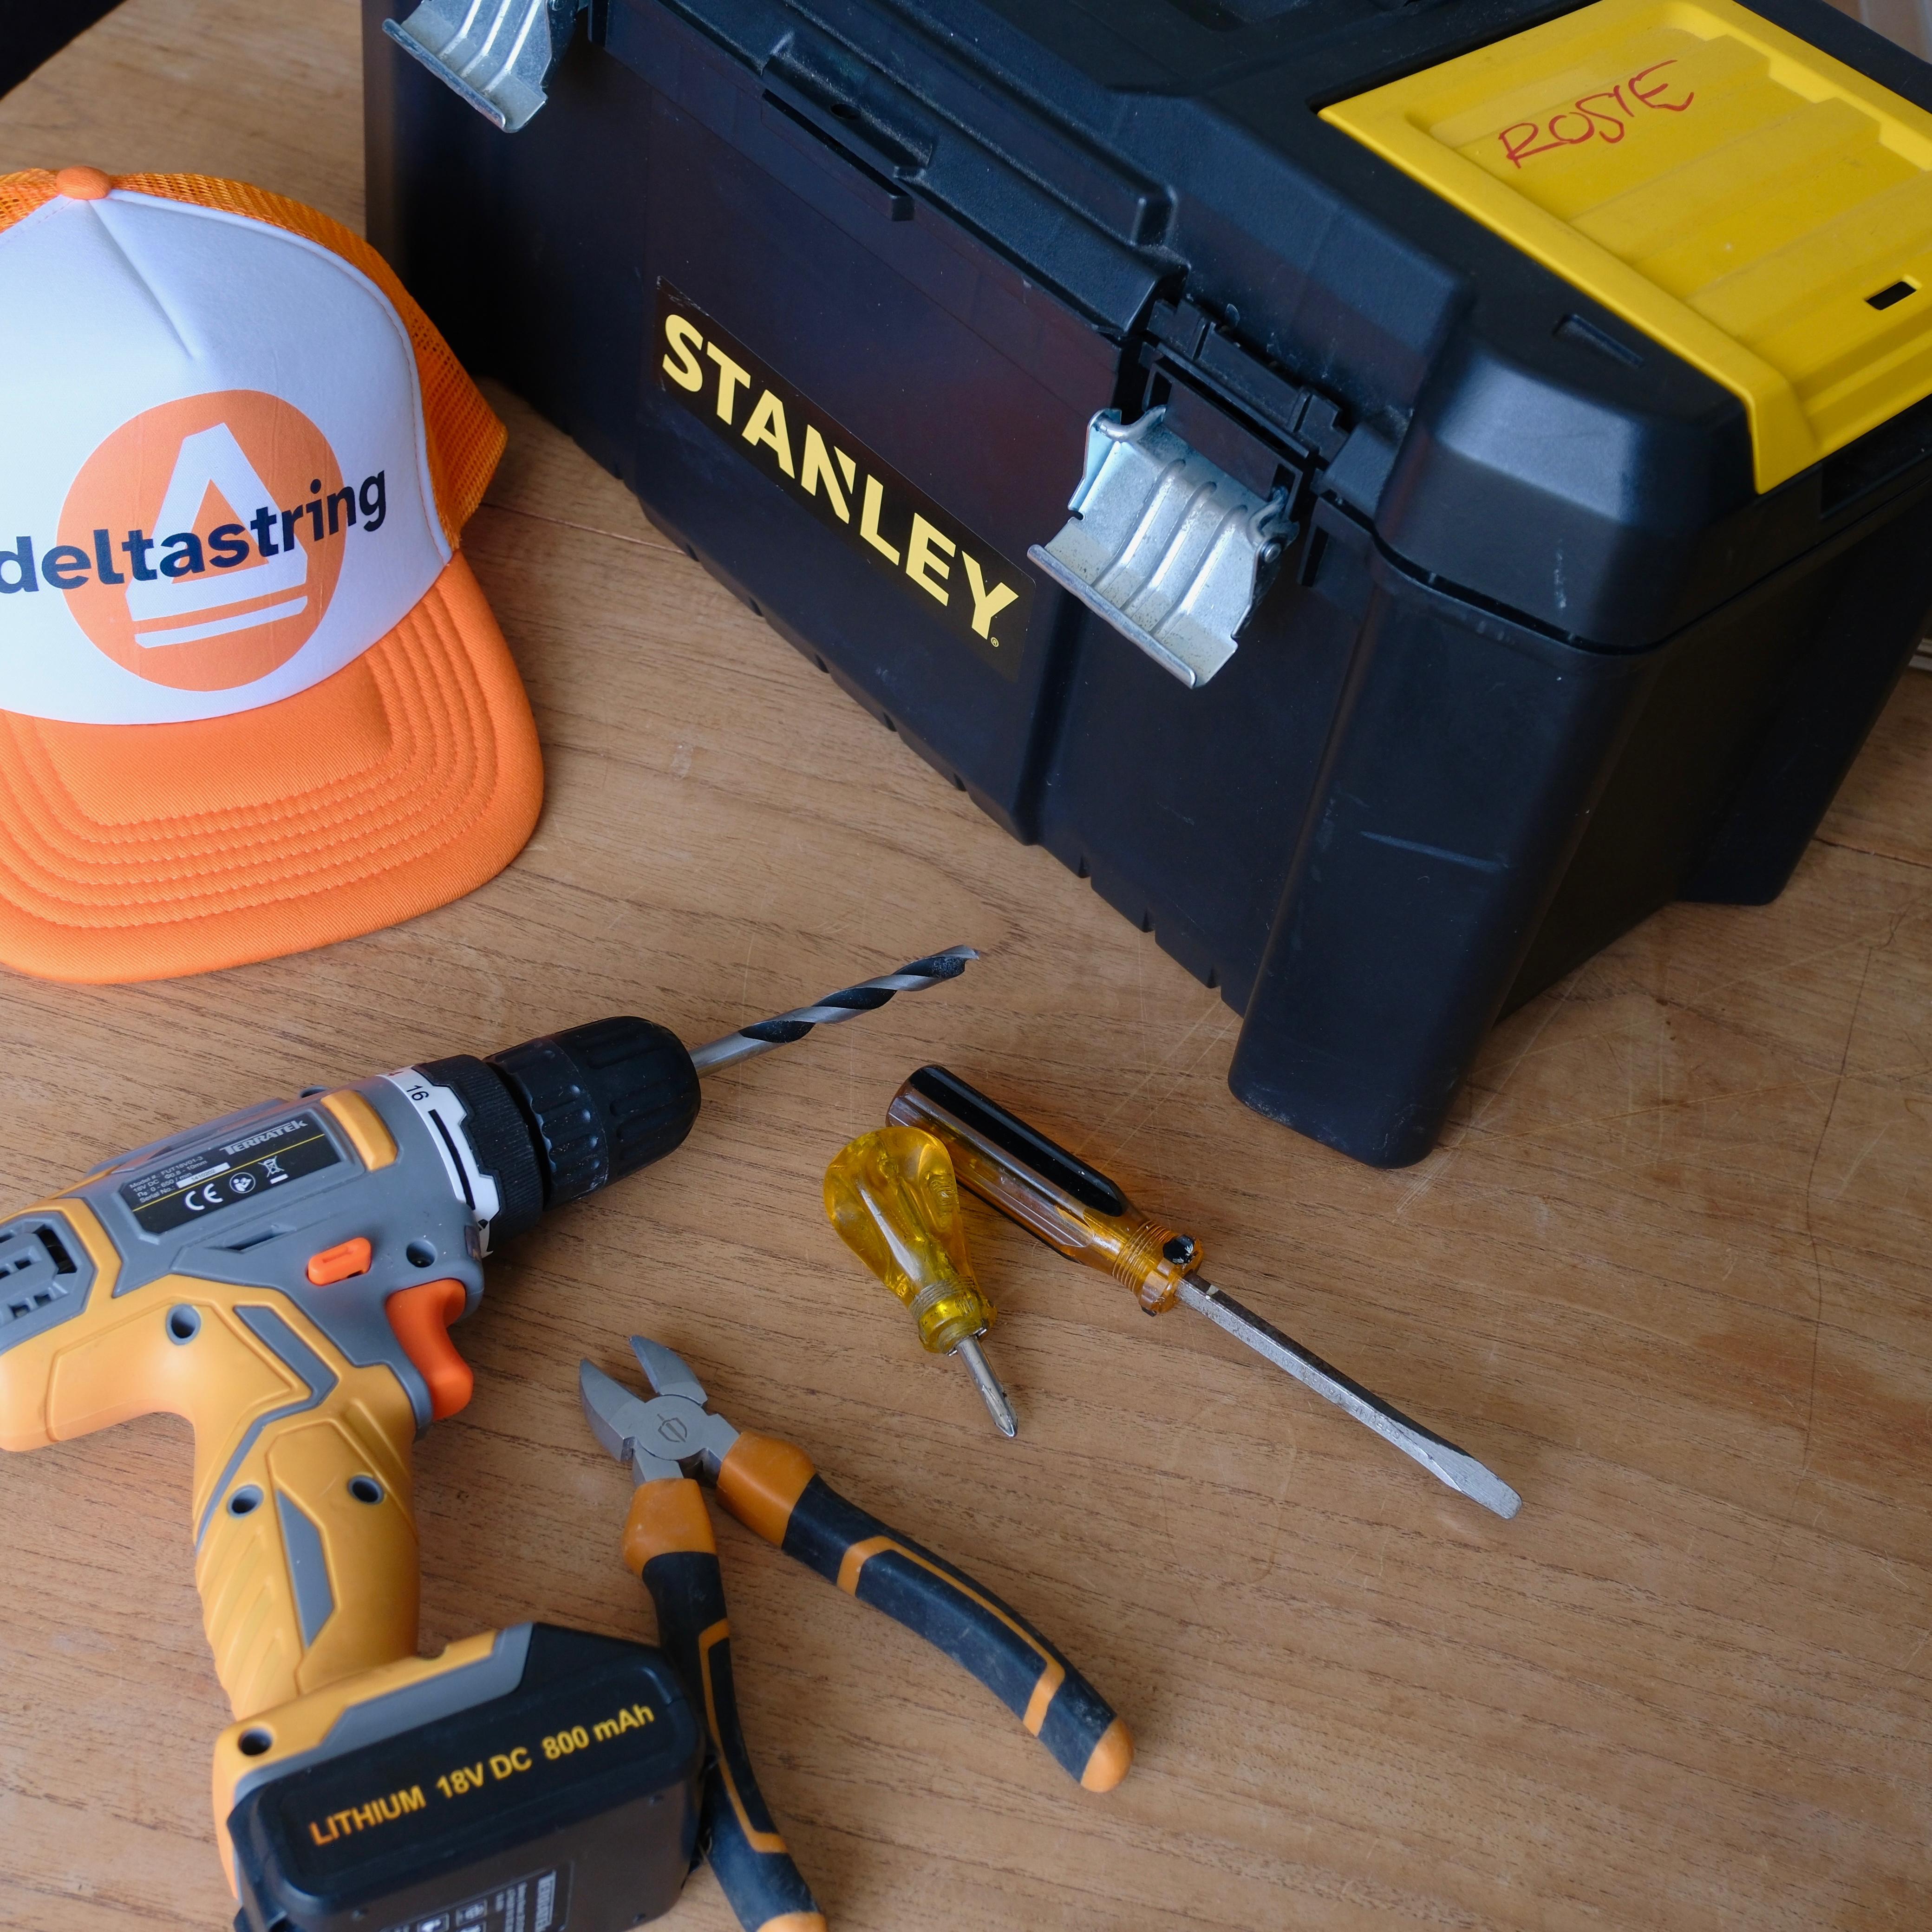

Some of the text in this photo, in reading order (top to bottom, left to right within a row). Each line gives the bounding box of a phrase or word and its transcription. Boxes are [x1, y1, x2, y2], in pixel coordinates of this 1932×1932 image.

[1499, 60, 1694, 168] ROSIE
[662, 314, 1018, 640] STANLEY
[0, 470, 386, 594] deltastring
[406, 1085, 429, 1101] 16
[130, 1177, 150, 1188] Model
[140, 1191, 160, 1202] Serial
[187, 1161, 207, 1170] 10mm
[308, 1704, 654, 1846] LITHIUM 18V DC 800 mAh
